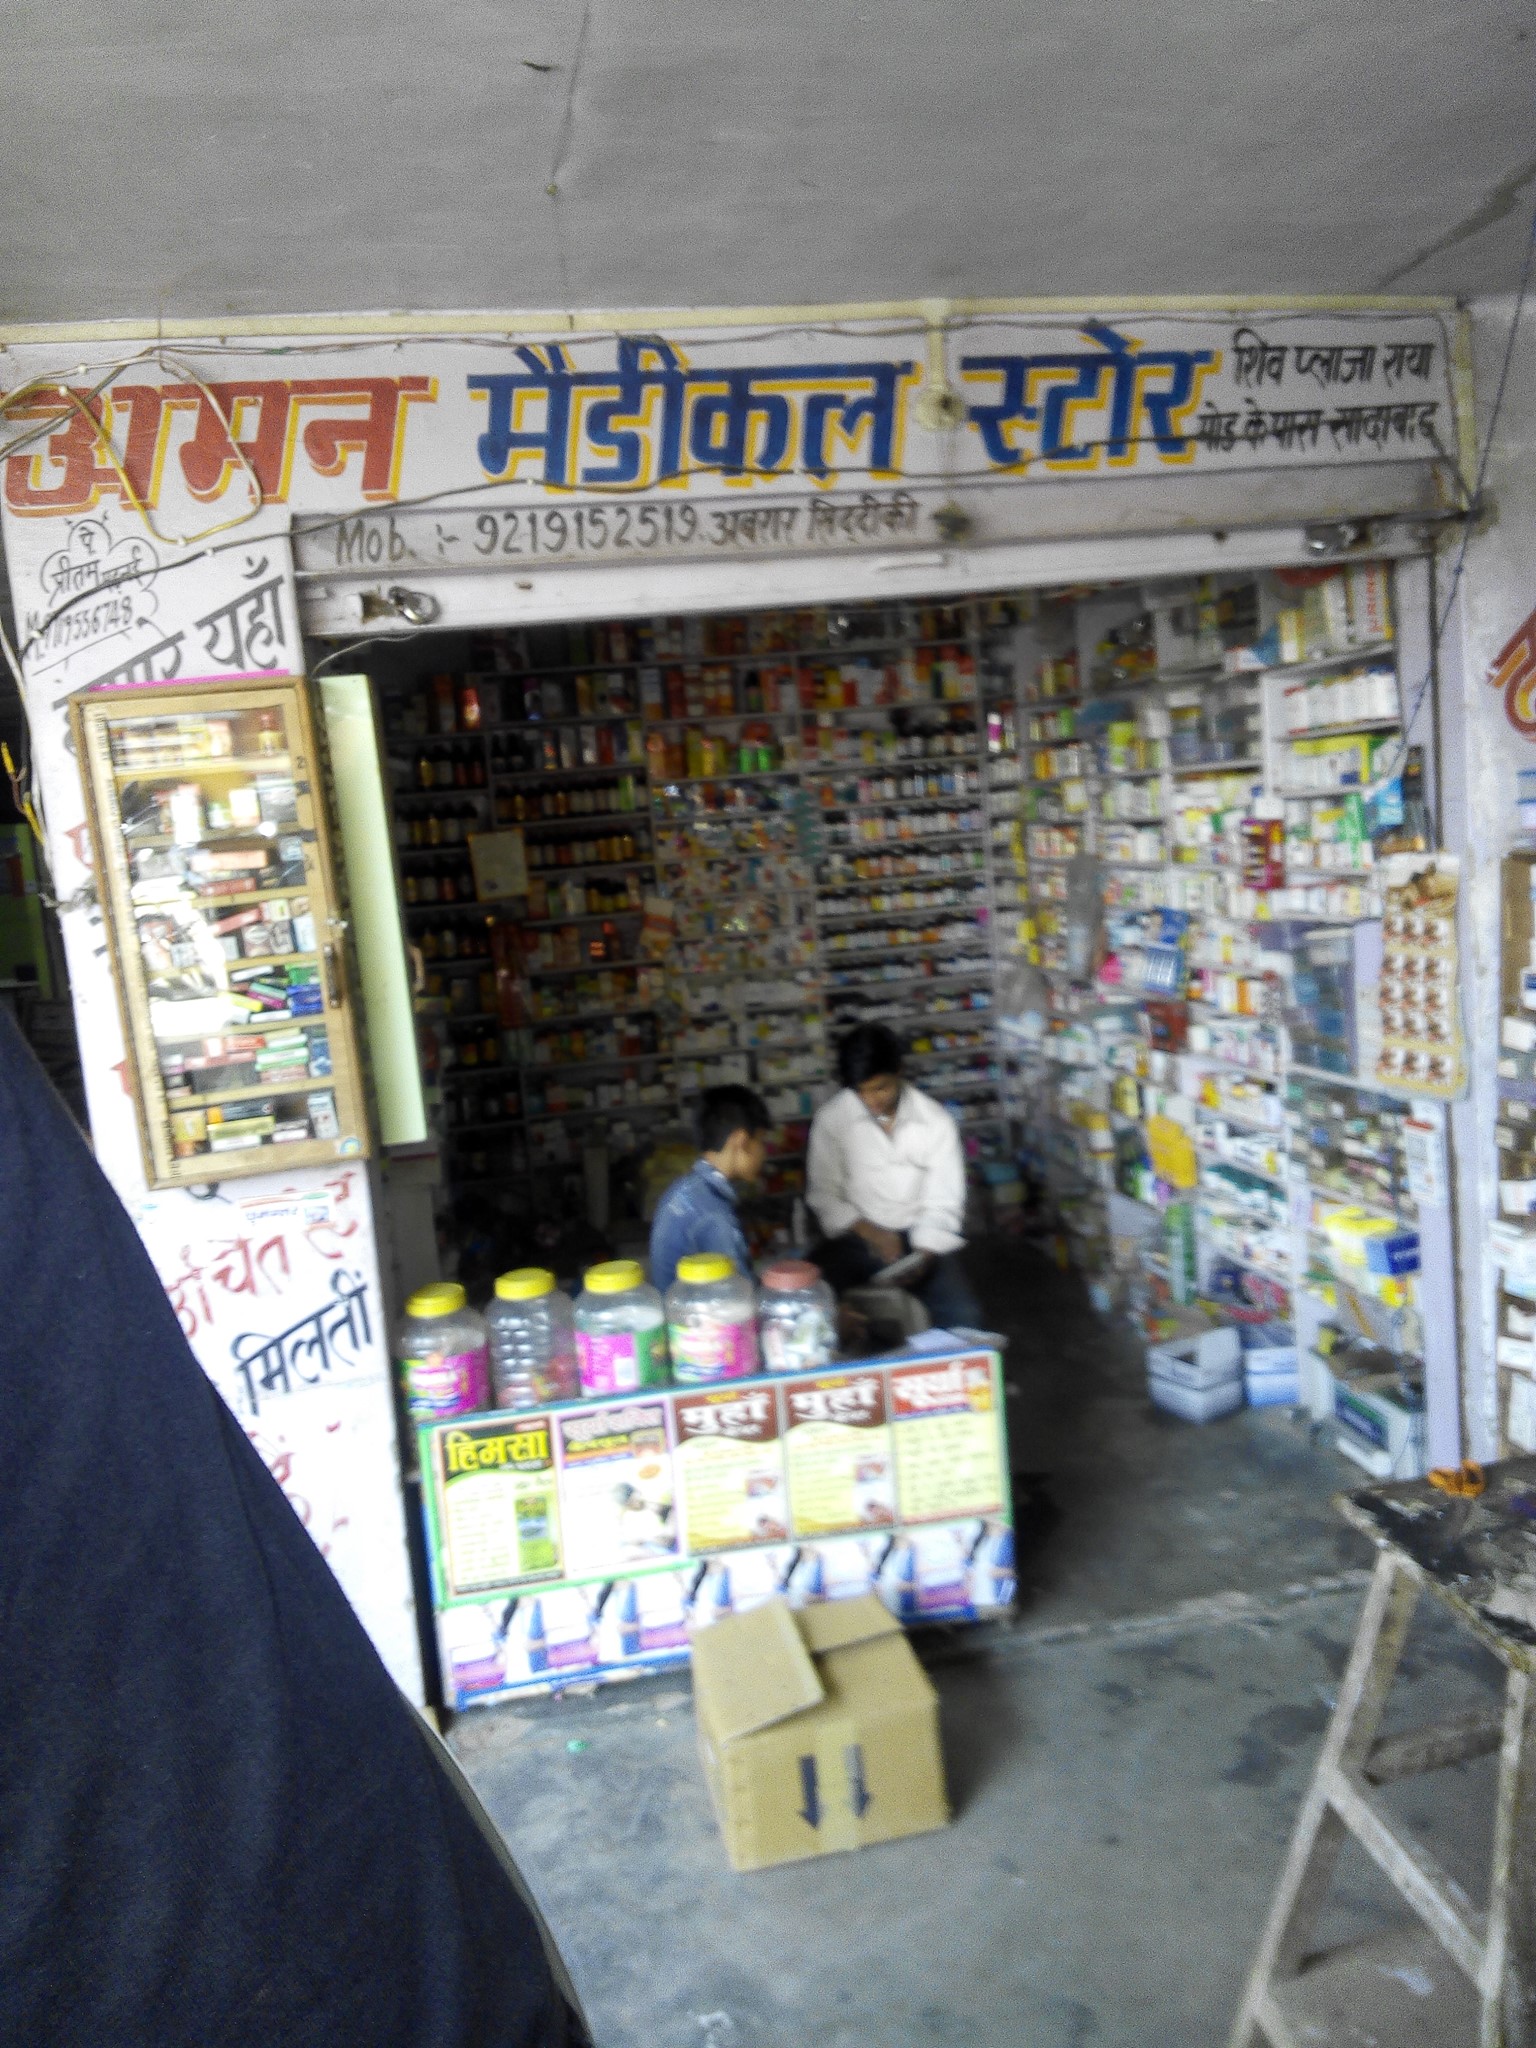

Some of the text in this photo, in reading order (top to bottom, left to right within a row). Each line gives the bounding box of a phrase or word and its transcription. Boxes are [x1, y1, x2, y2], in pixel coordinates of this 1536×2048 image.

[0, 376, 438, 517] अमन
[962, 319, 1222, 475] स्टोर
[1233, 327, 1288, 388] शिव
